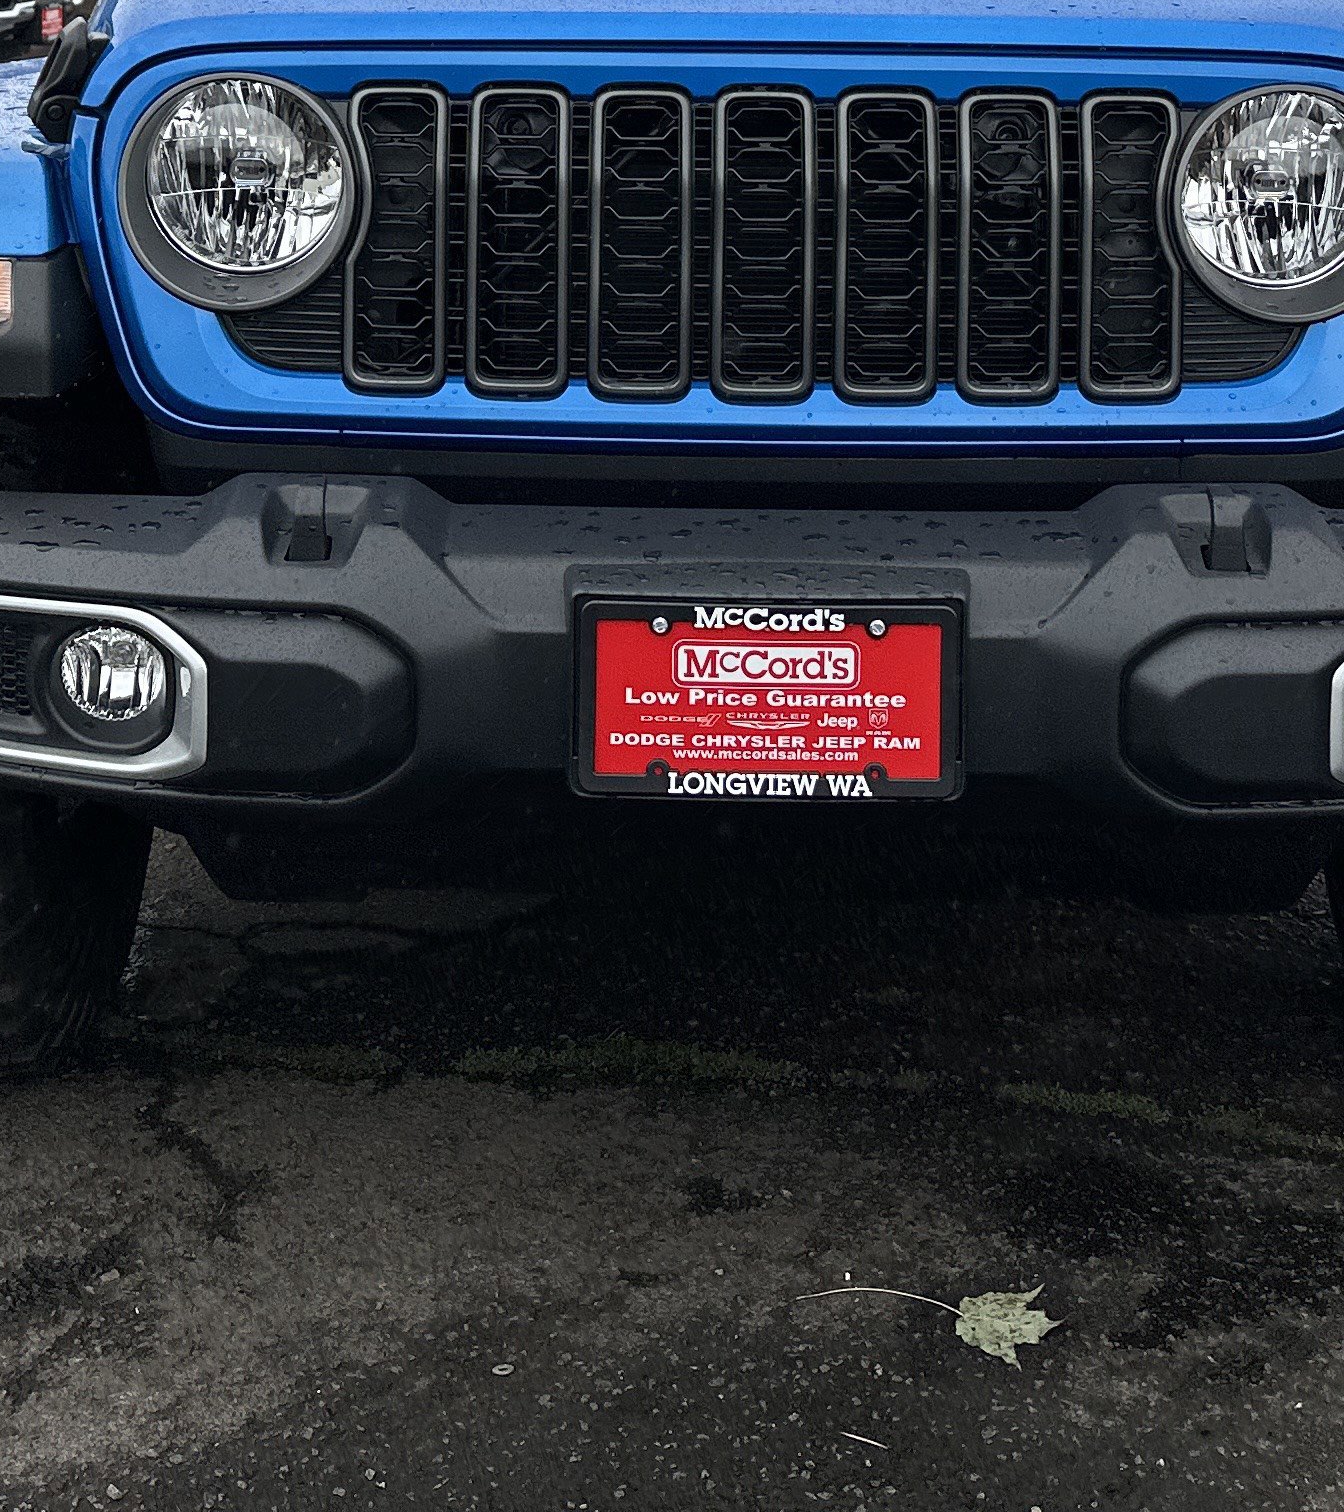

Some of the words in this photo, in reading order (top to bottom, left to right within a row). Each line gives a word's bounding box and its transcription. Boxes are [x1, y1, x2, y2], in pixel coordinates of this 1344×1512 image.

[694, 606, 845, 632] McCord's
[684, 649, 849, 681] McCord's
[625, 688, 678, 705] Low
[689, 689, 757, 707] Price
[766, 690, 906, 708] Guarantee
[640, 715, 706, 723] DODGE
[726, 712, 811, 720] CHRYSLER
[817, 713, 858, 730] Jeep
[609, 732, 684, 746] DODGE
[692, 734, 805, 749] CHRYSLER
[812, 735, 866, 749] JEEP
[873, 737, 921, 750] RAM
[673, 749, 859, 762] www.mccordsales.com
[668, 772, 817, 796] LONGVIEW
[827, 774, 873, 797] WA
